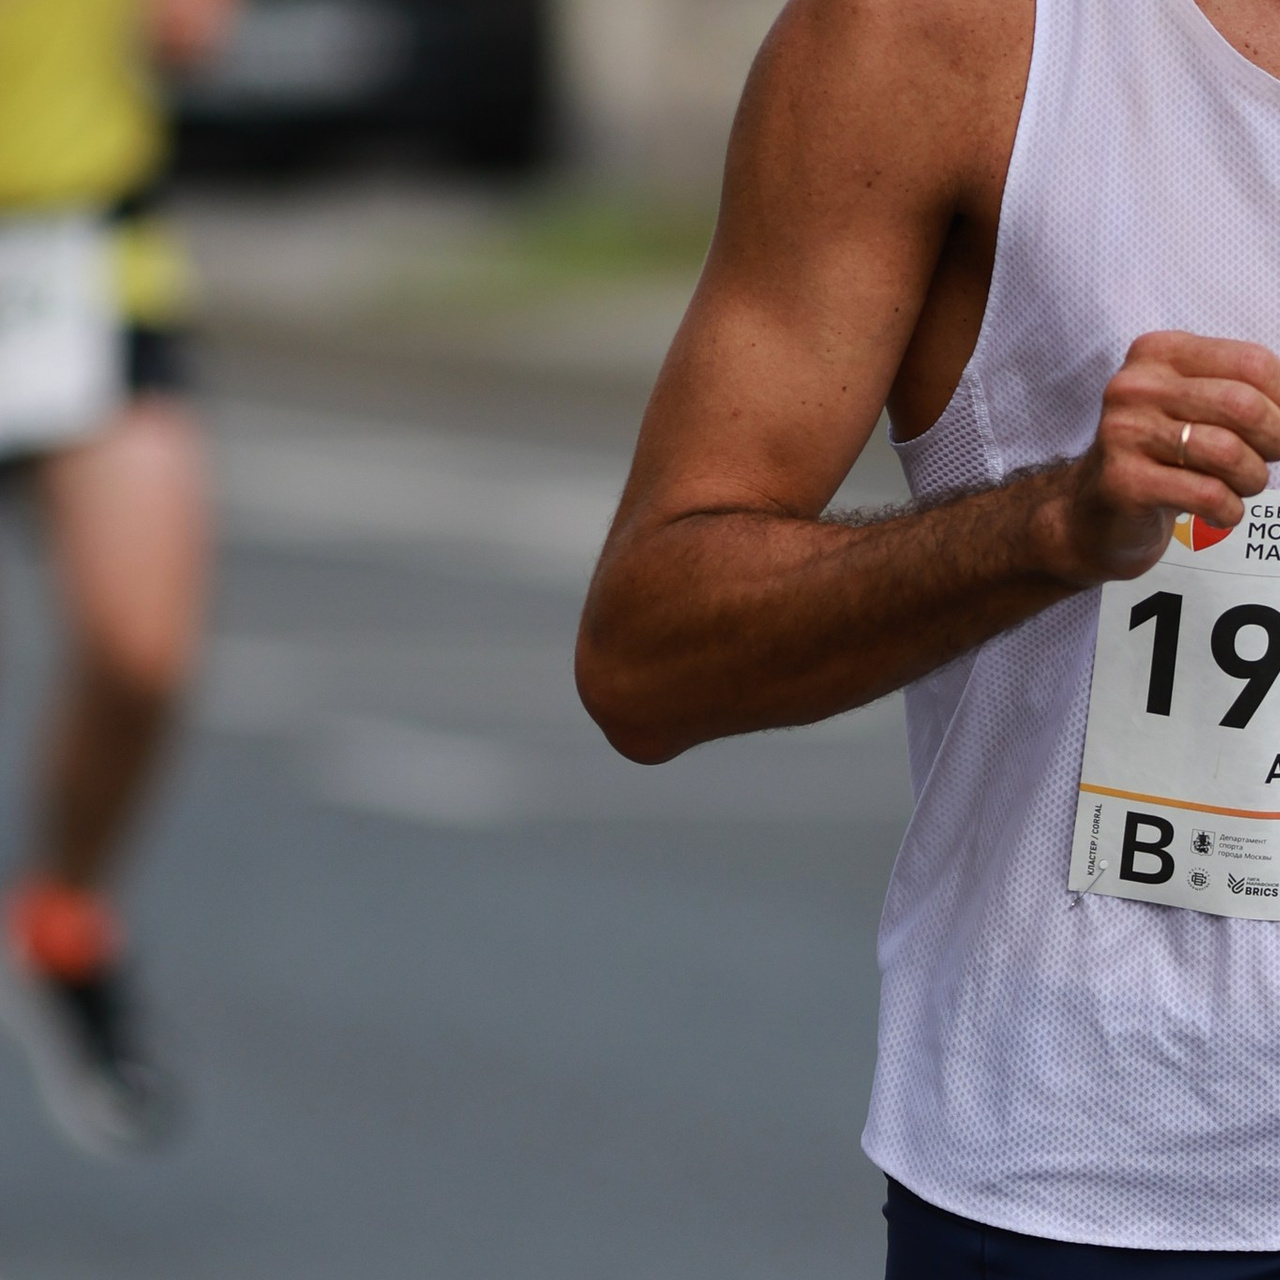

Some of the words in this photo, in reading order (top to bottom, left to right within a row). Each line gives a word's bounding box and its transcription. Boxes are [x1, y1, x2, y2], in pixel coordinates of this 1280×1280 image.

[1091, 803, 1103, 834] CORRAL
[1219, 833, 1267, 845] Департамент
[1218, 842, 1244, 851] спорта
[1087, 840, 1098, 876] КЛАСТЕР
[1218, 850, 1243, 859] города
[1243, 852, 1272, 861] Москвы
[1245, 886, 1279, 898] BRICS
